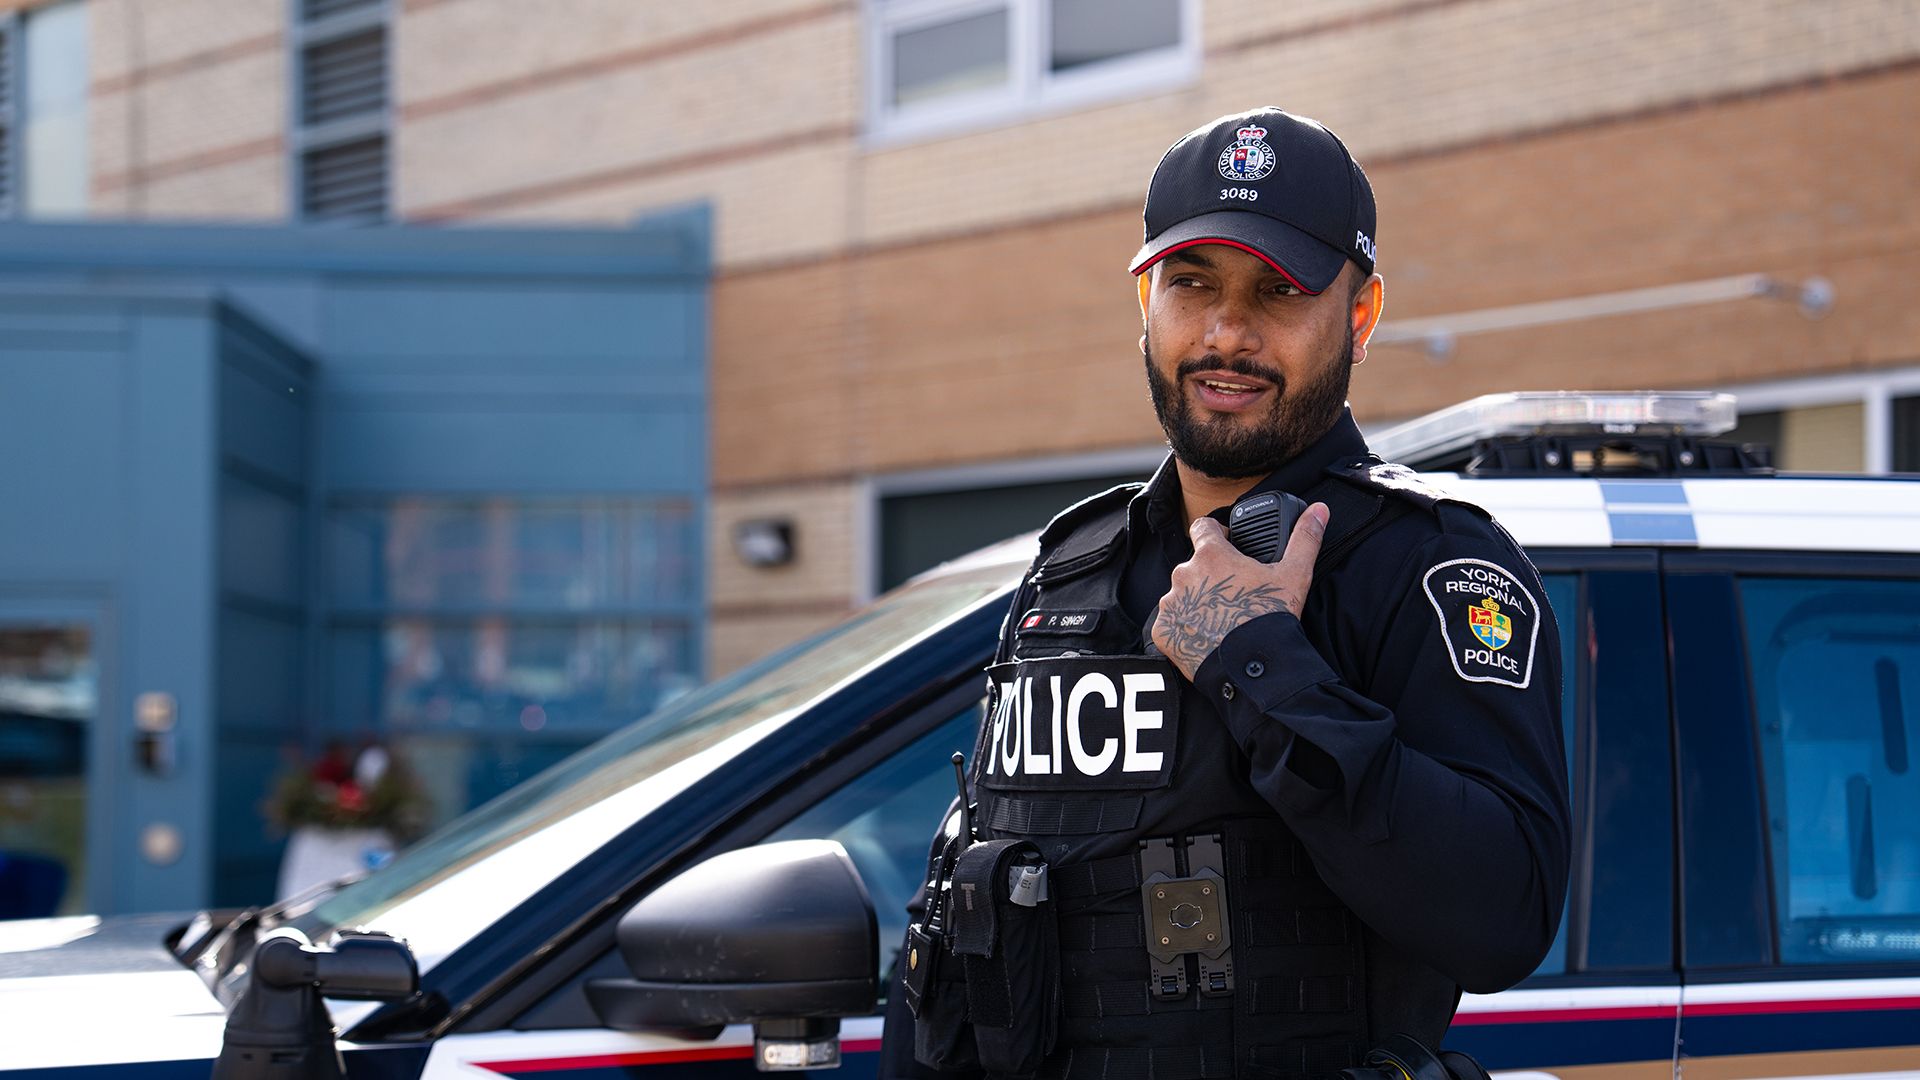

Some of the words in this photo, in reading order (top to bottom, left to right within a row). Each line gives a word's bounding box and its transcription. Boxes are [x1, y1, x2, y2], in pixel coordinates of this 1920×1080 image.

[1220, 144, 1237, 173] YORK
[1236, 139, 1274, 170] REGIONAL
[1226, 169, 1263, 179] POLICE
[1219, 187, 1259, 202] 3089
[1244, 499, 1274, 512] MOTOROLA
[1460, 568, 1512, 593] YORK
[1445, 581, 1527, 616] REGIONAL
[1047, 615, 1057, 626] P.
[1060, 614, 1088, 627] SINGH
[1464, 648, 1519, 676] POLICE
[986, 672, 1166, 777] POLICE
